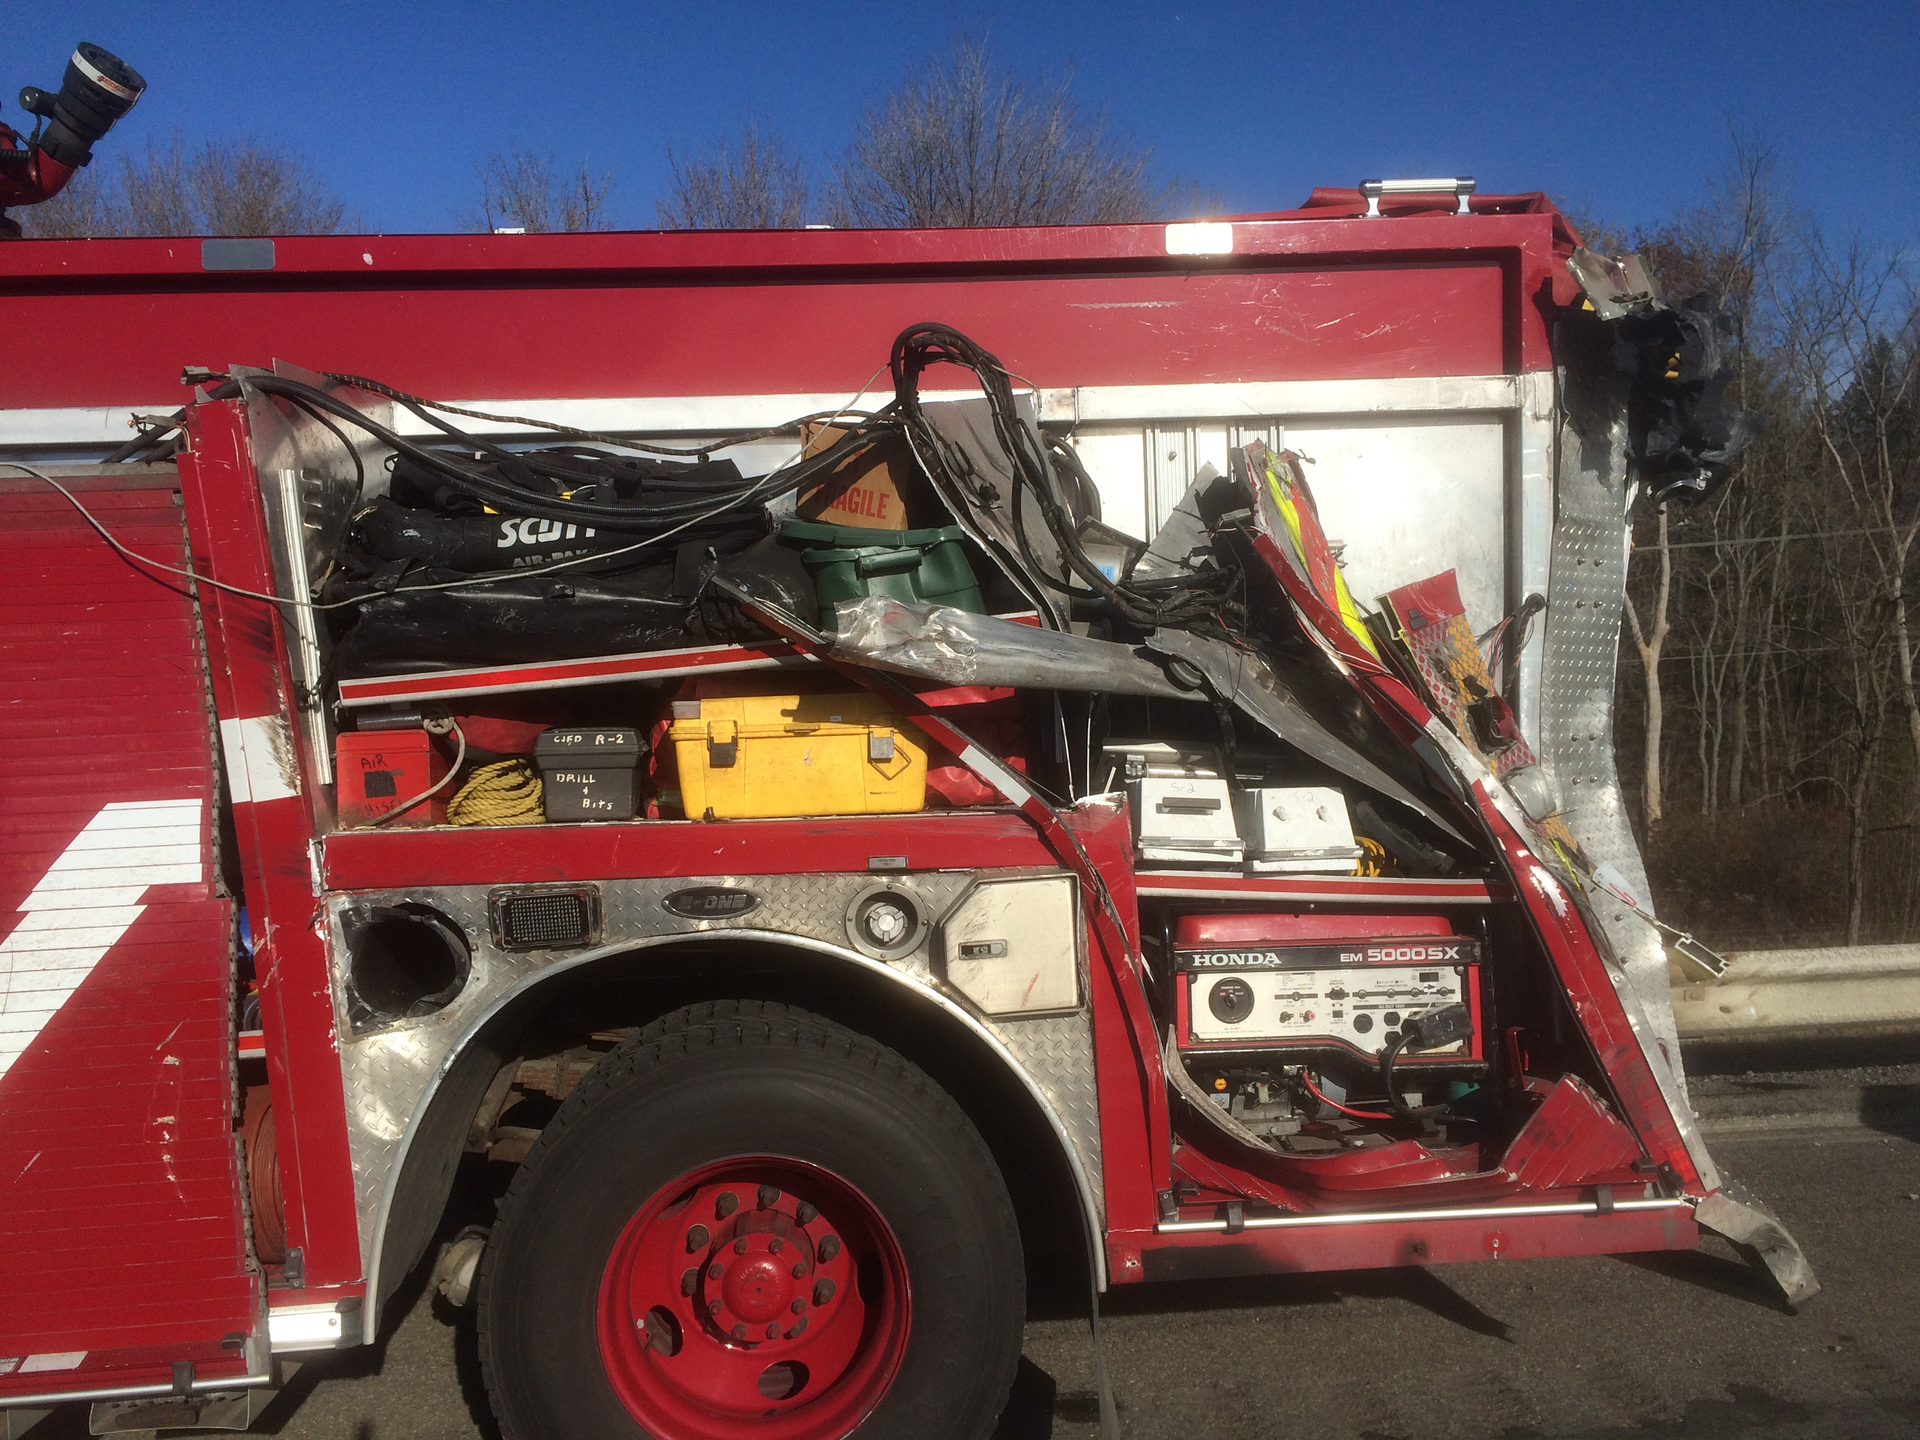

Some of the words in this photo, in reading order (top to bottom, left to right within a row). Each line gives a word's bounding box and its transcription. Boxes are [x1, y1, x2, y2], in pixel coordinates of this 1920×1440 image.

[829, 487, 890, 520] AGILE
[595, 734, 624, 745] R-2
[360, 754, 387, 769] AIR
[556, 773, 596, 783] DRILL
[1192, 952, 1282, 967] HONDA
[1340, 953, 1363, 962] EM
[1368, 946, 1460, 961] 5000SX
